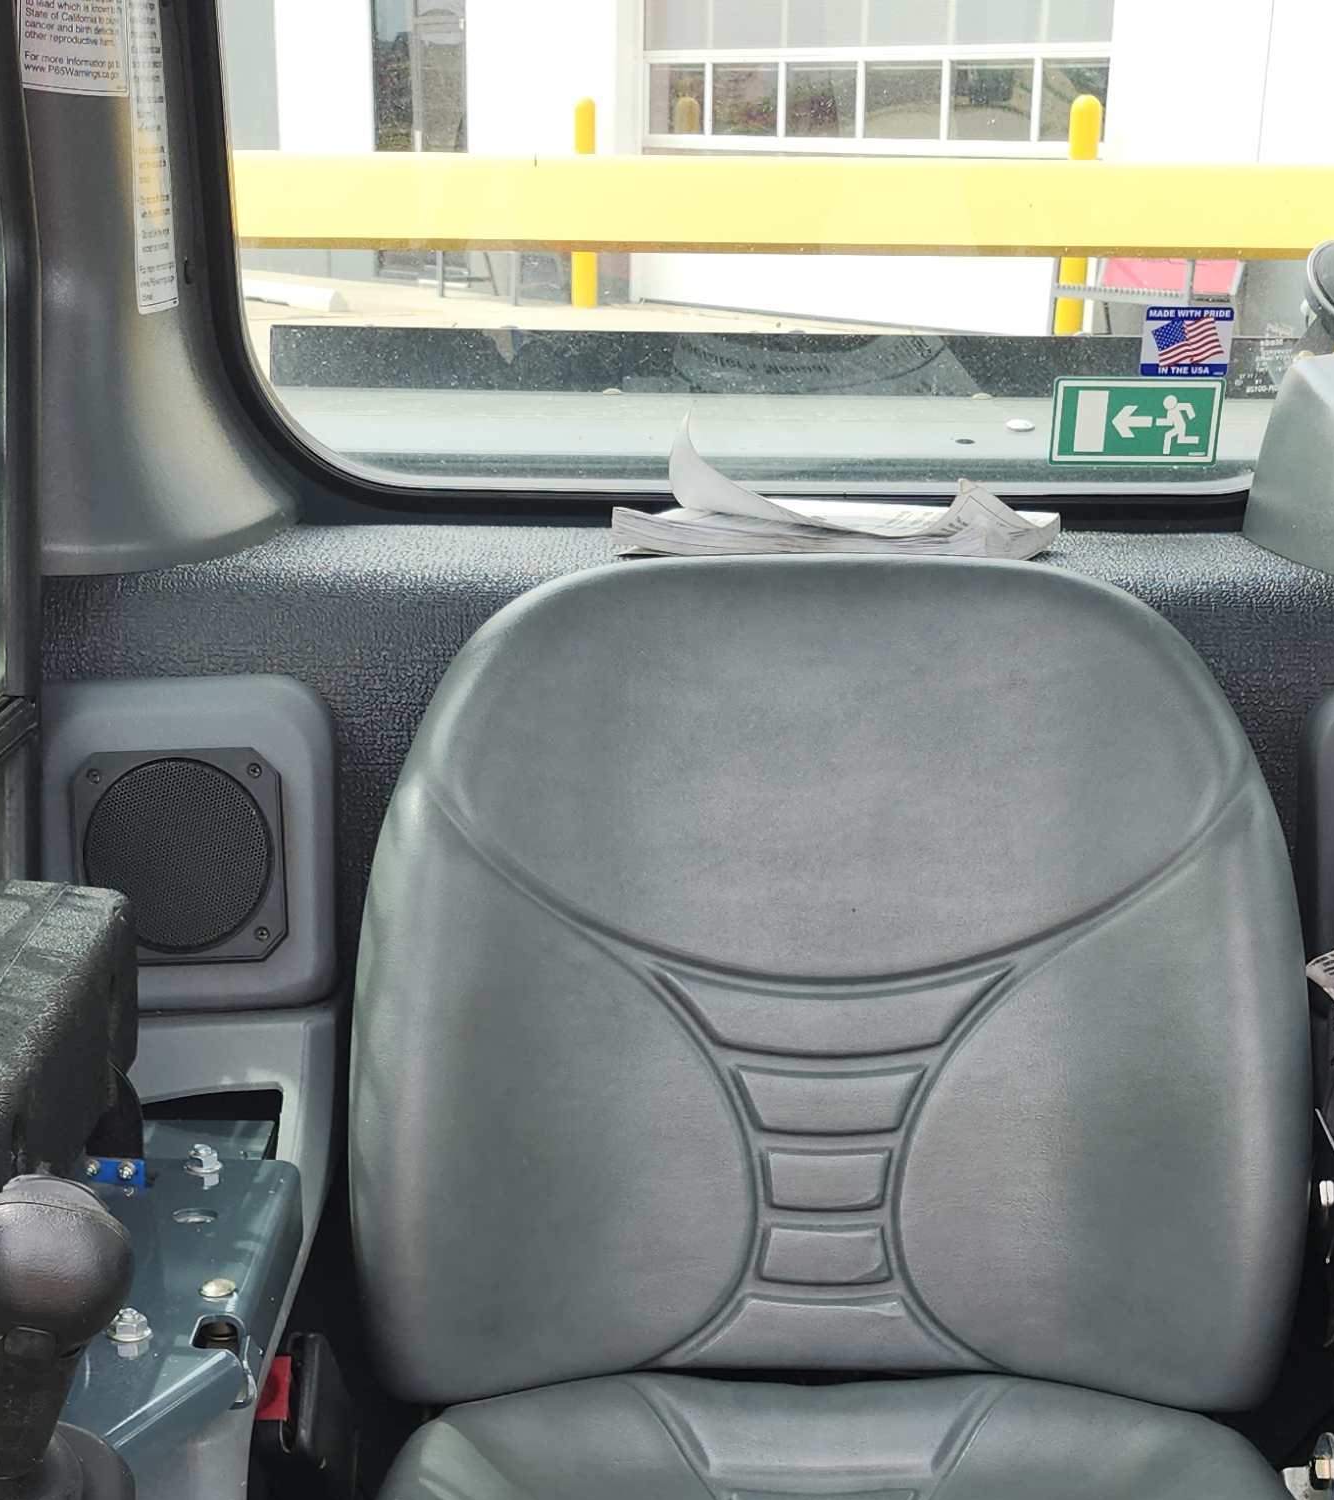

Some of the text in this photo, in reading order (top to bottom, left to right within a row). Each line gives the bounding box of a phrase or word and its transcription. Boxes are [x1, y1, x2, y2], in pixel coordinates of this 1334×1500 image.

[57, 1, 81, 12] which
[25, 7, 49, 19] State
[50, 11, 60, 20] of
[61, 12, 97, 24] California
[24, 20, 55, 31] cancer
[57, 24, 74, 33] and
[75, 25, 93, 35] birth
[24, 30, 48, 40] other
[49, 34, 99, 46] reproductive
[24, 51, 40, 62] For
[41, 55, 64, 64] more
[66, 56, 107, 69] information
[1148, 309, 1232, 318] MADE WITH PRIDE
[1157, 366, 1169, 375] IN
[1170, 366, 1189, 375] THE
[1190, 366, 1211, 375] USA
